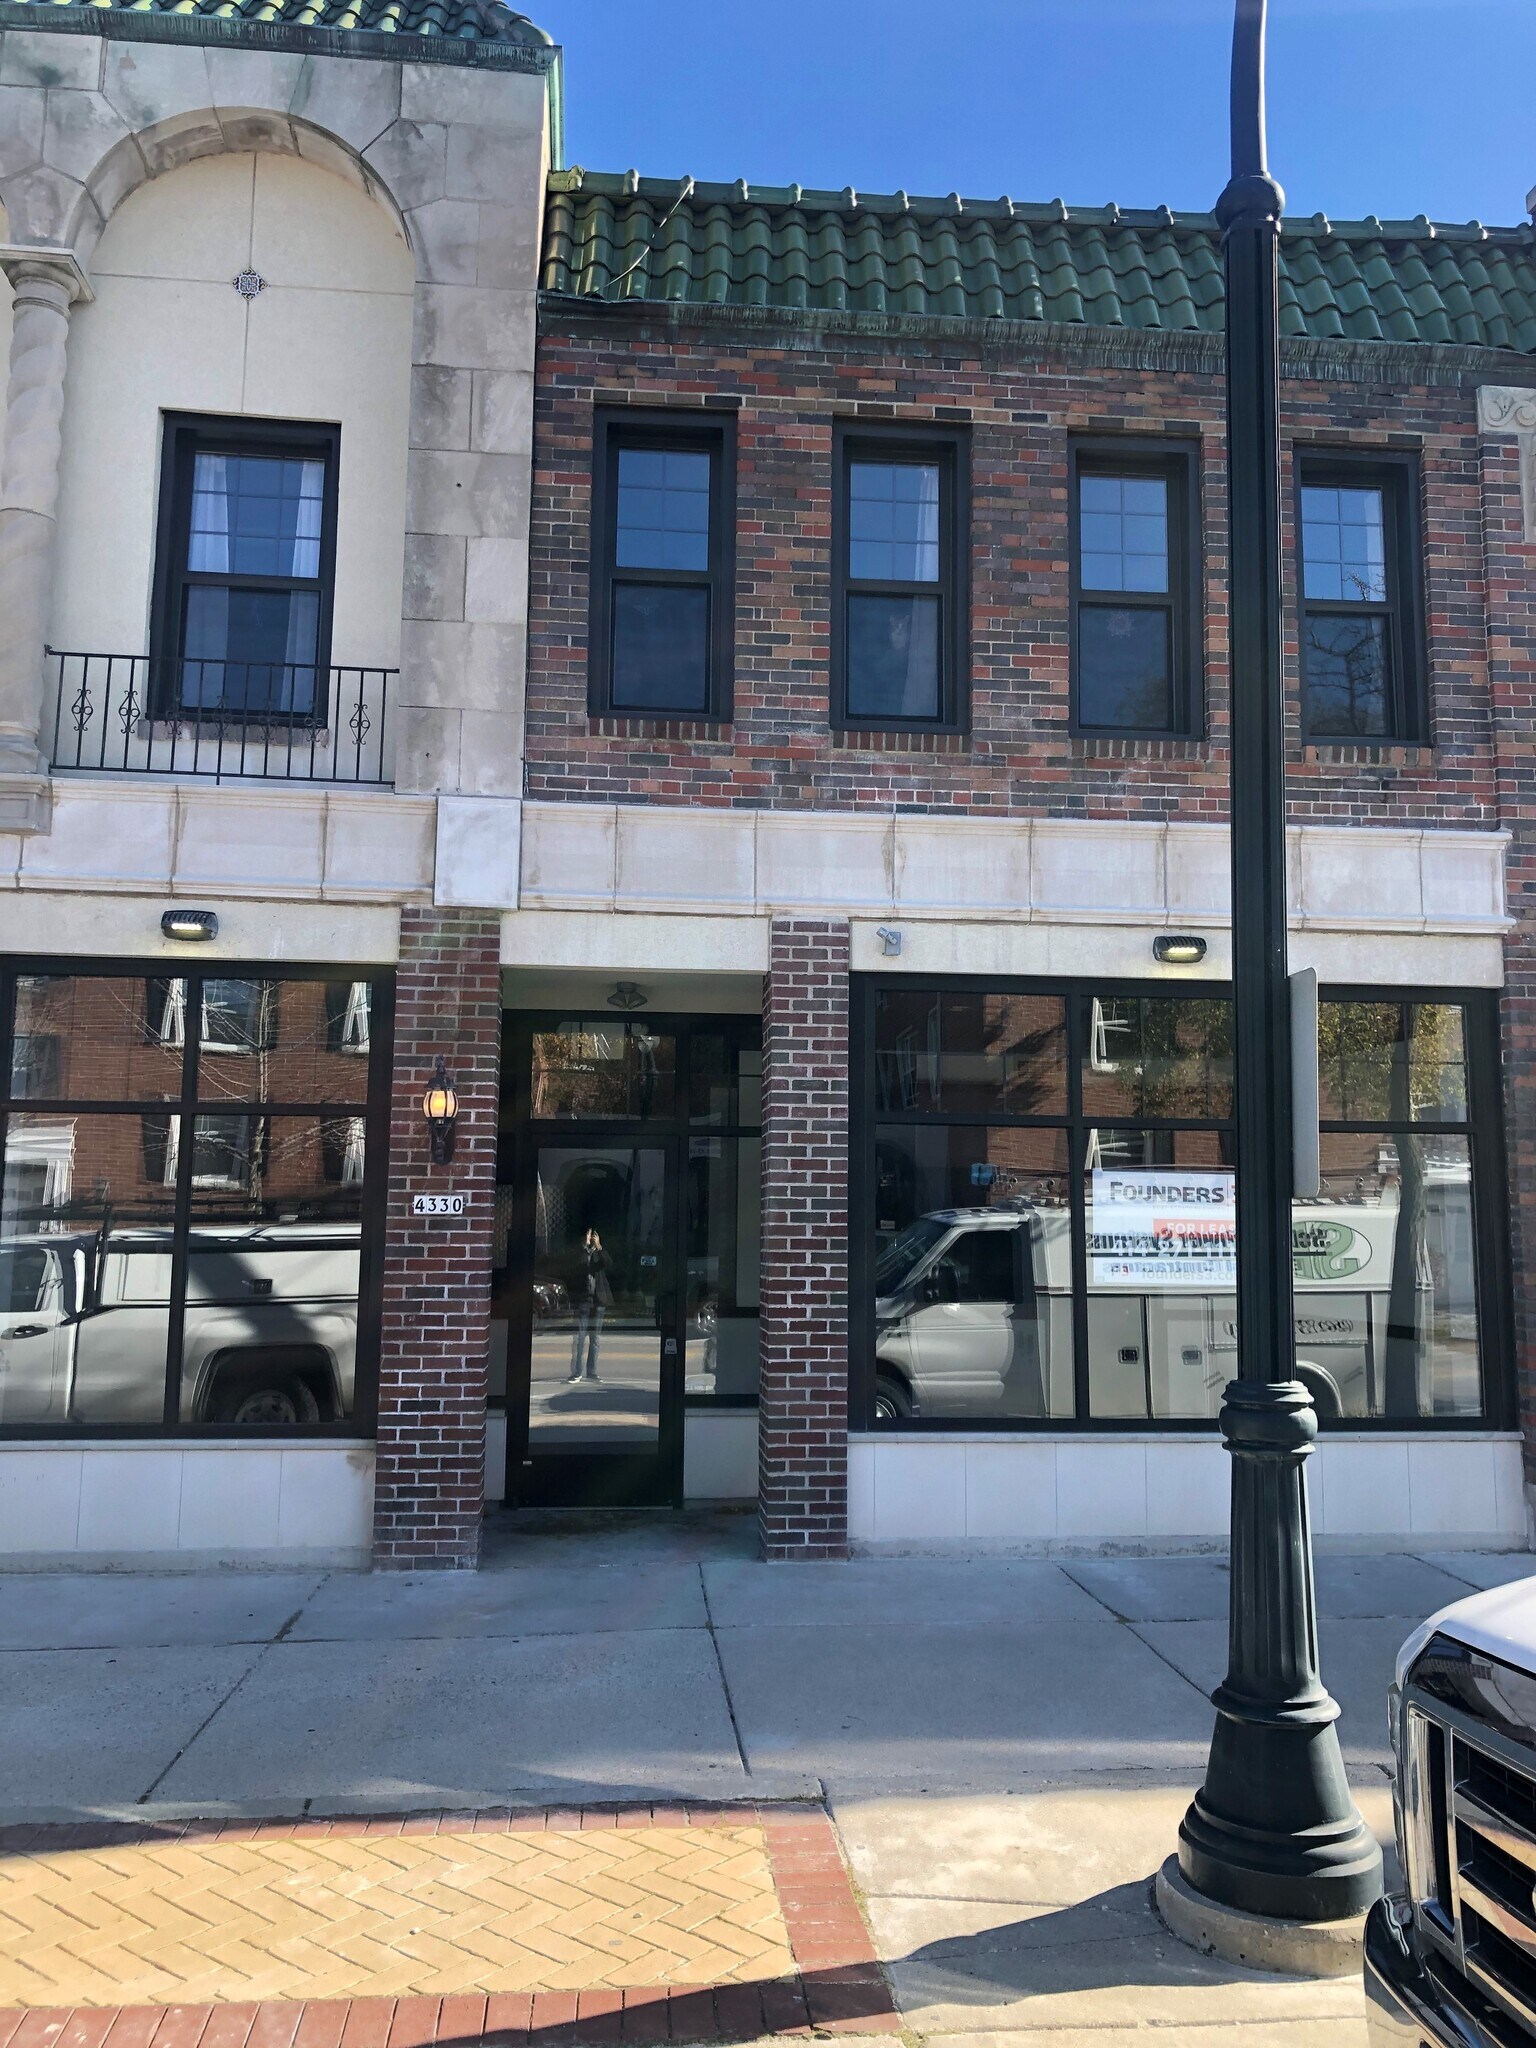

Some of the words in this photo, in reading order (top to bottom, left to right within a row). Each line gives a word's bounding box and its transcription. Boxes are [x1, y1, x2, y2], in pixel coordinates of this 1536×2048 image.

[1110, 1181, 1225, 1203] FOUNDERS
[415, 1198, 461, 1212] 4330
[1166, 1223, 1196, 1235] FOR
[1200, 1223, 1236, 1236] LEAS
[1110, 1239, 1236, 1258] 414-271-111
[1141, 1270, 1234, 1281] founders3.co
